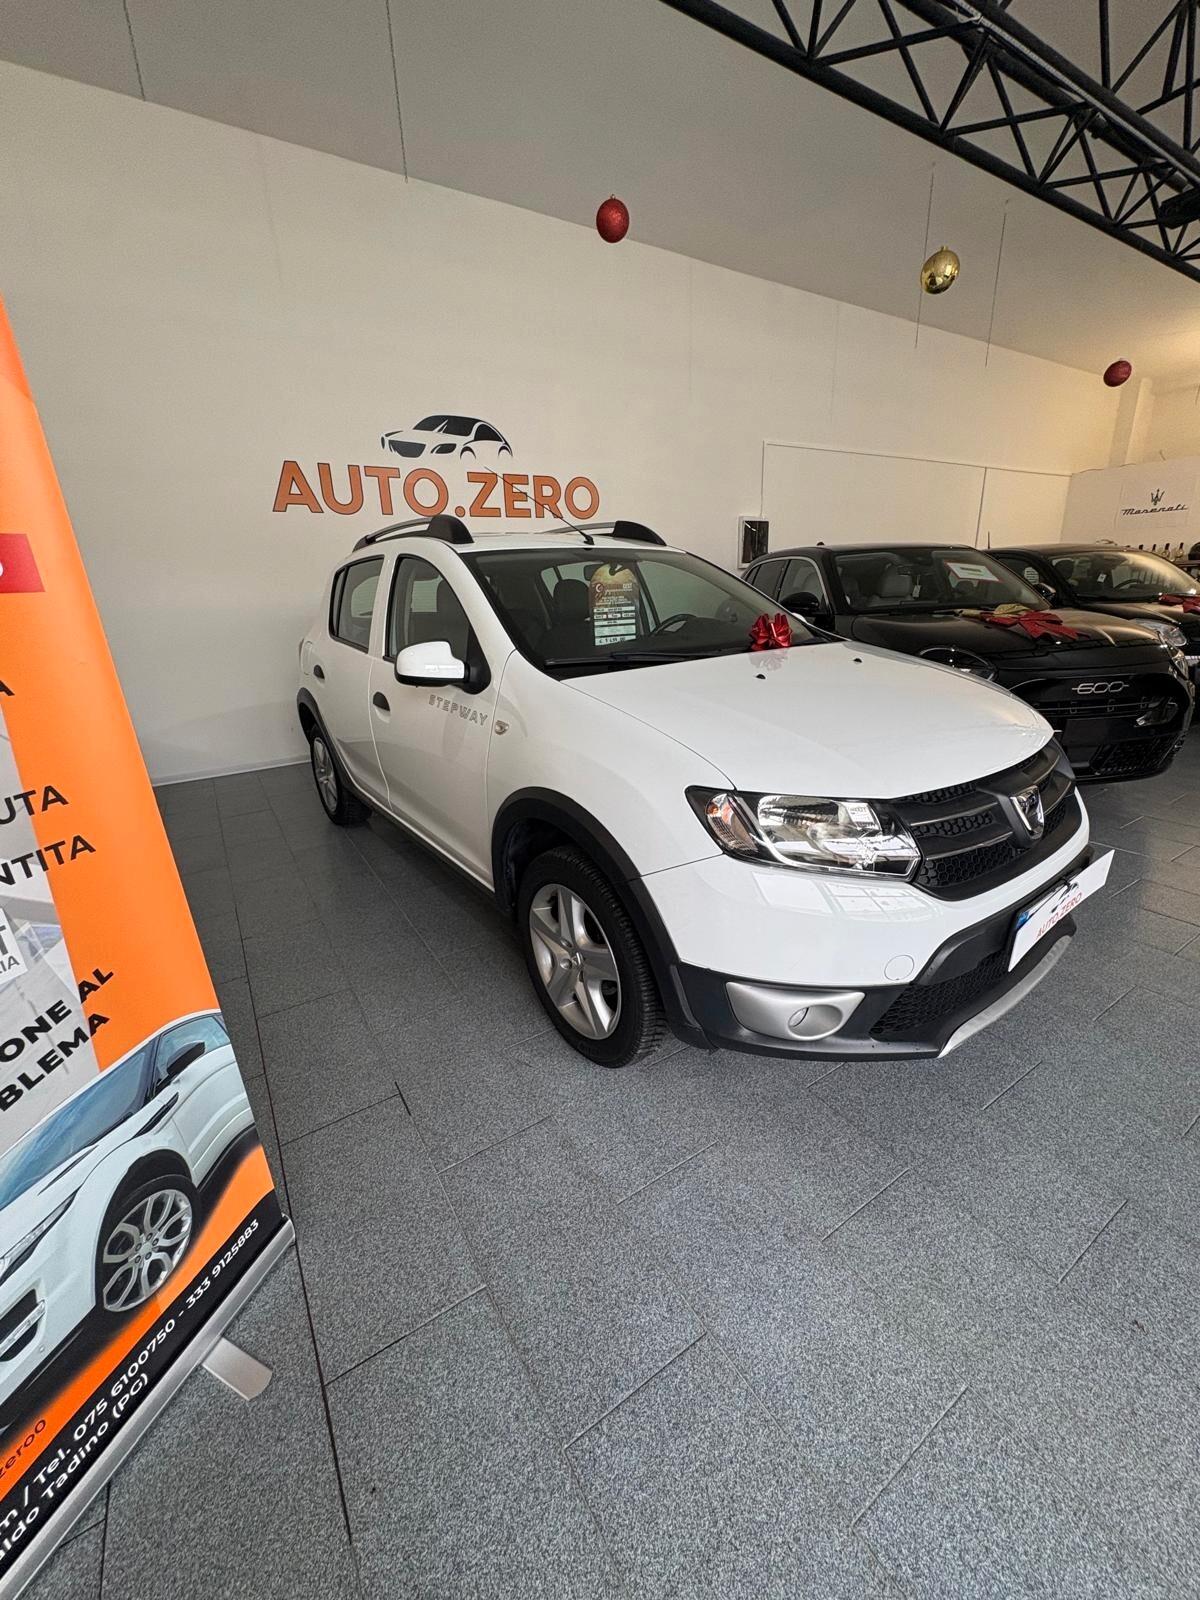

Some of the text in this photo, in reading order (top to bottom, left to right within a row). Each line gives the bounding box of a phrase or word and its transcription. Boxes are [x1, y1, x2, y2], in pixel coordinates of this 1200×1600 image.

[272, 460, 600, 518] AUTO.ZERO
[1121, 503, 1188, 516] Maserati
[1072, 680, 1129, 695] 600
[428, 694, 489, 727] STEPWAY
[1036, 892, 1083, 939] AUTO ZERO
[77, 967, 115, 1005] AL
[33, 1447, 71, 1485] Tel.
[73, 1398, 109, 1442] 075
[110, 1318, 176, 1398] 6100750
[186, 1275, 212, 1310] 333
[211, 1218, 260, 1276] 9125883
[41, 1421, 109, 1500] Tadino
[112, 1372, 149, 1419] (PG)
